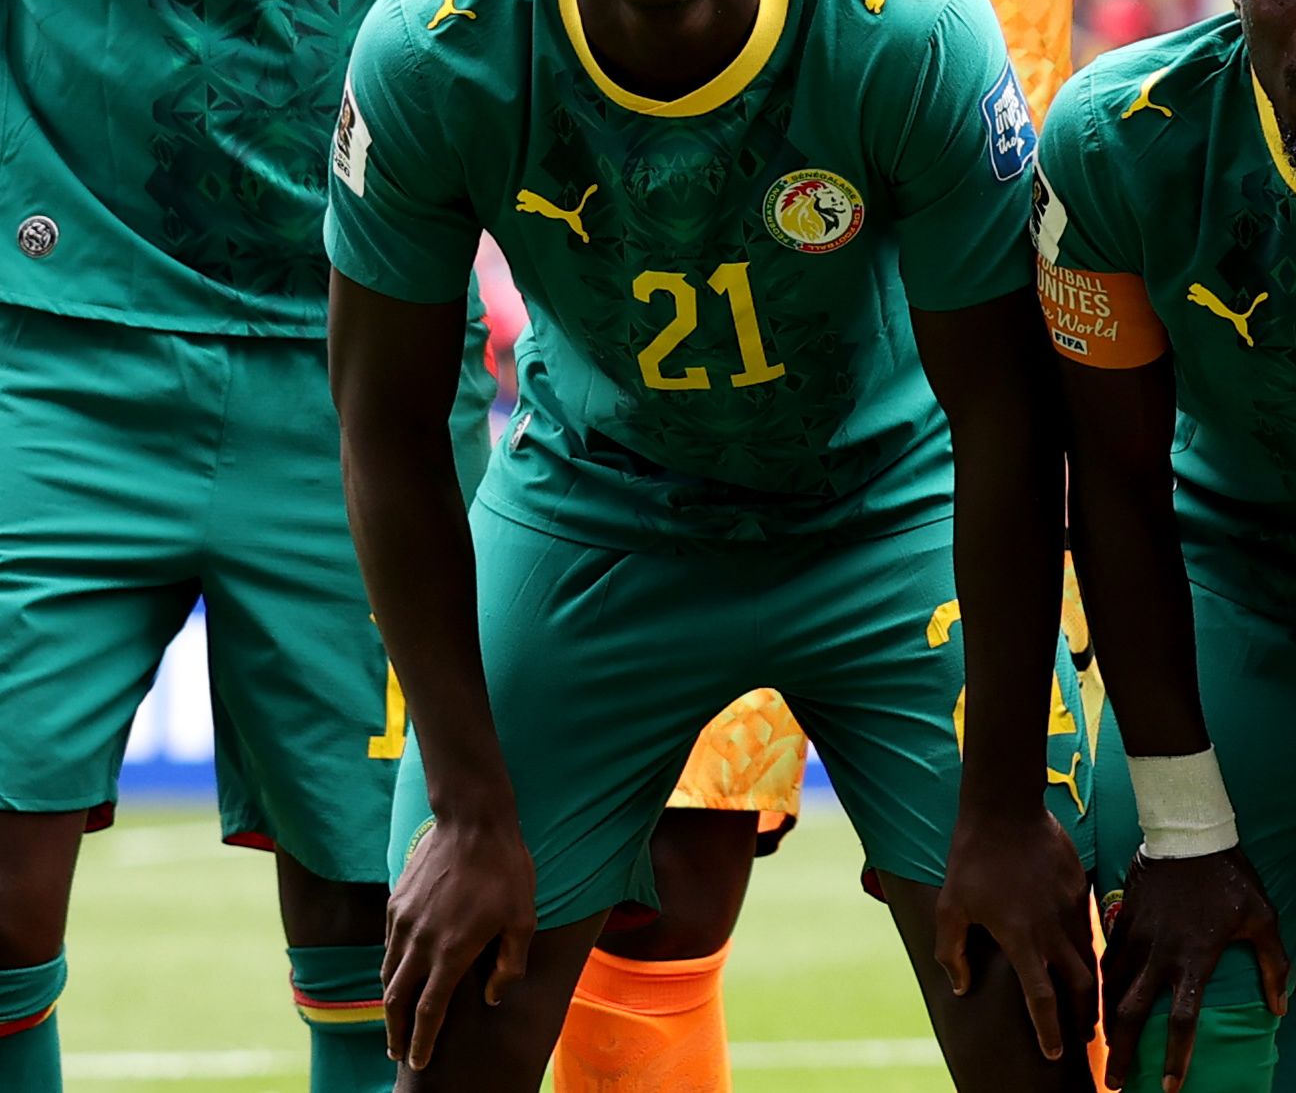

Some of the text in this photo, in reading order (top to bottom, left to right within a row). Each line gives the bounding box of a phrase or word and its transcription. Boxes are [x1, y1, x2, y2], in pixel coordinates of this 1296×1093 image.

[1037, 264, 1111, 318] UNITES
[1038, 255, 1107, 294] OOTBALL
[633, 262, 784, 390] 21
[1054, 332, 1085, 352] FIFA
[1057, 307, 1119, 342] World
